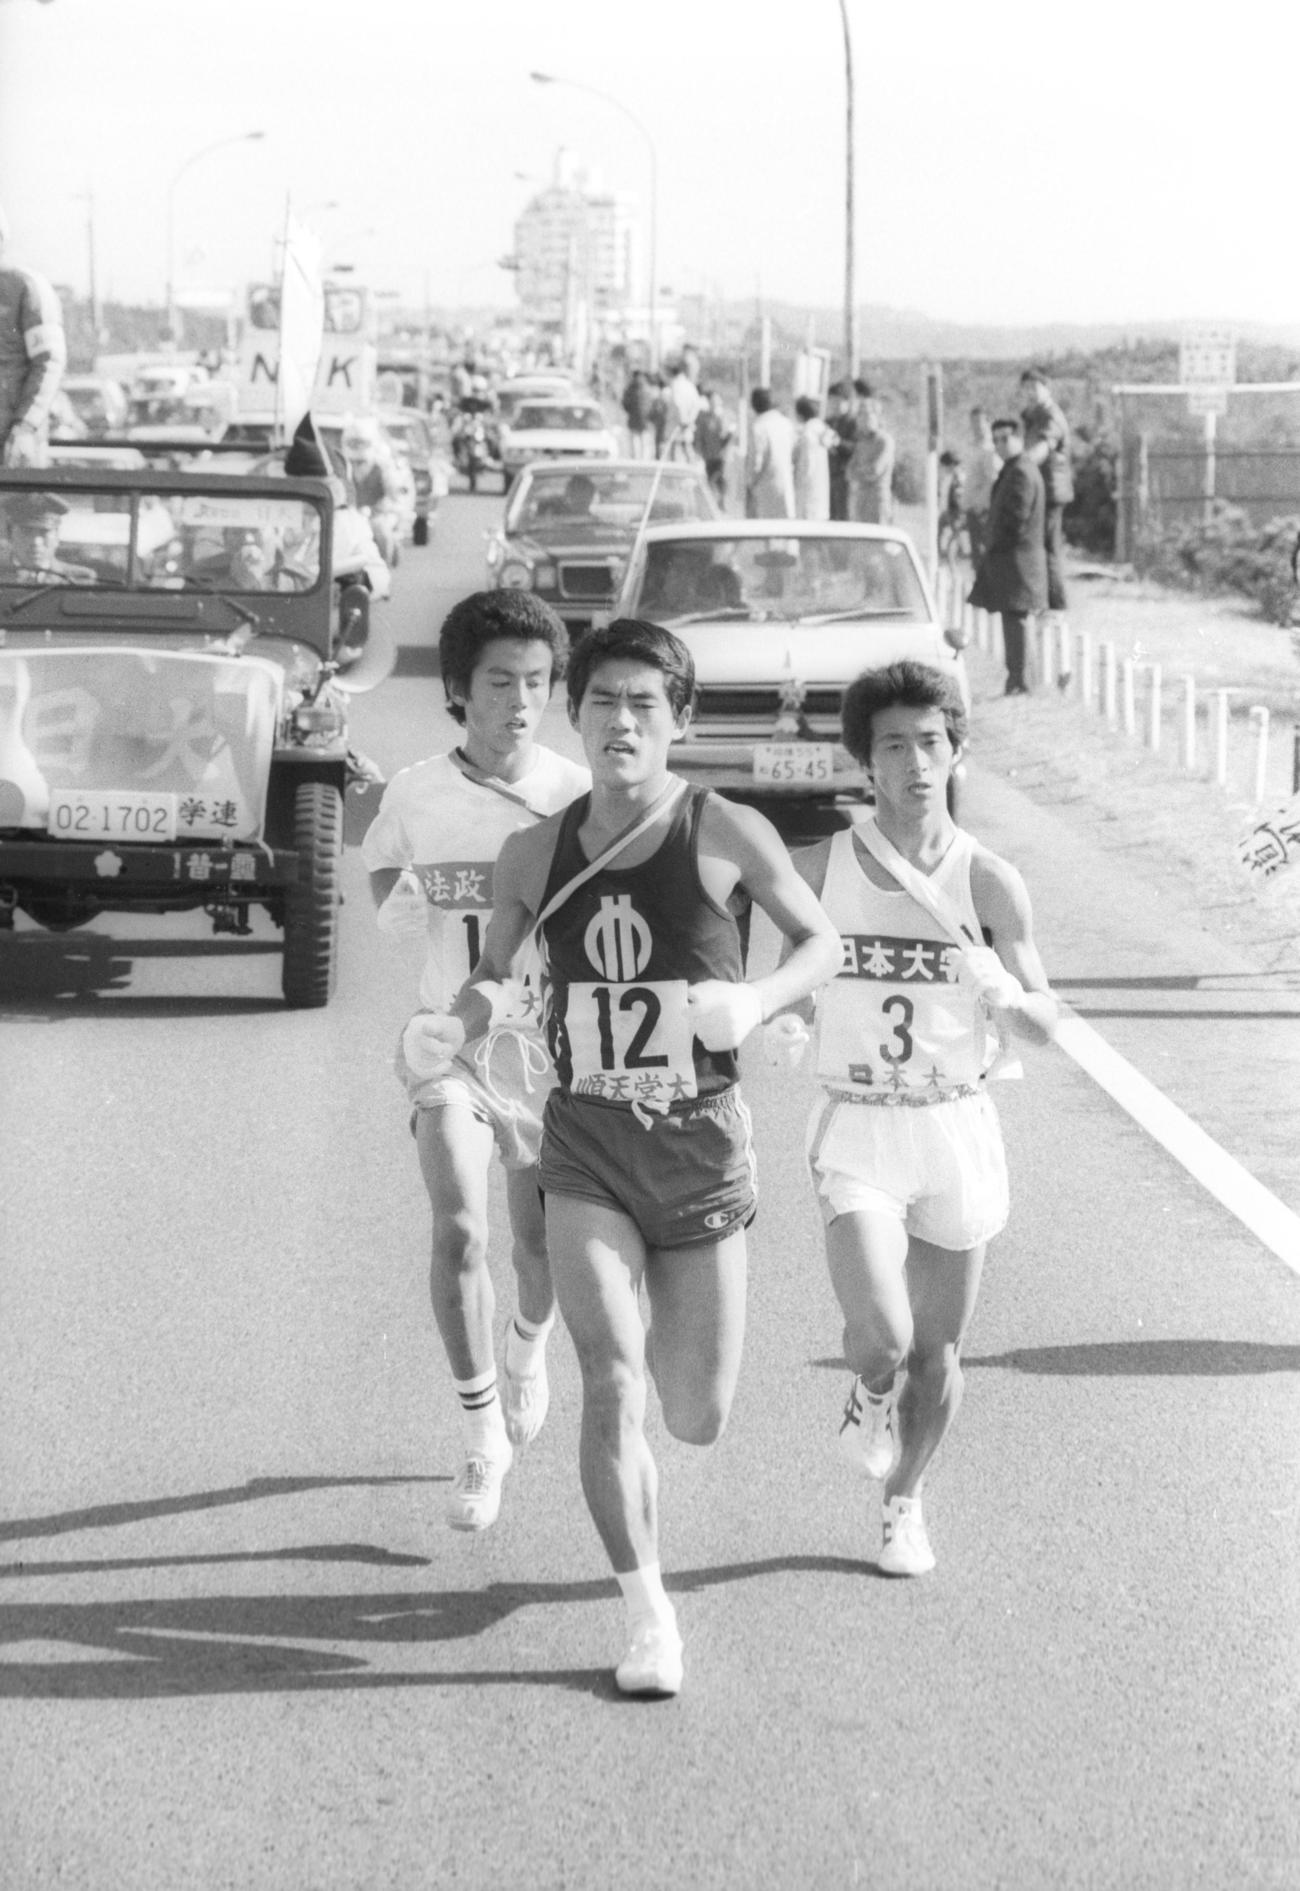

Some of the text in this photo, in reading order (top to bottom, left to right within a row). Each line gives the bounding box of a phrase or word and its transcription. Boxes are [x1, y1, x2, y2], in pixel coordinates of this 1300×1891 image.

[250, 352, 359, 388] NK
[57, 804, 168, 833] 02-1702
[179, 797, 239, 828] 学連
[591, 987, 669, 1070] 12
[879, 994, 914, 1064] 3
[576, 1072, 693, 1101] 順天堂大
